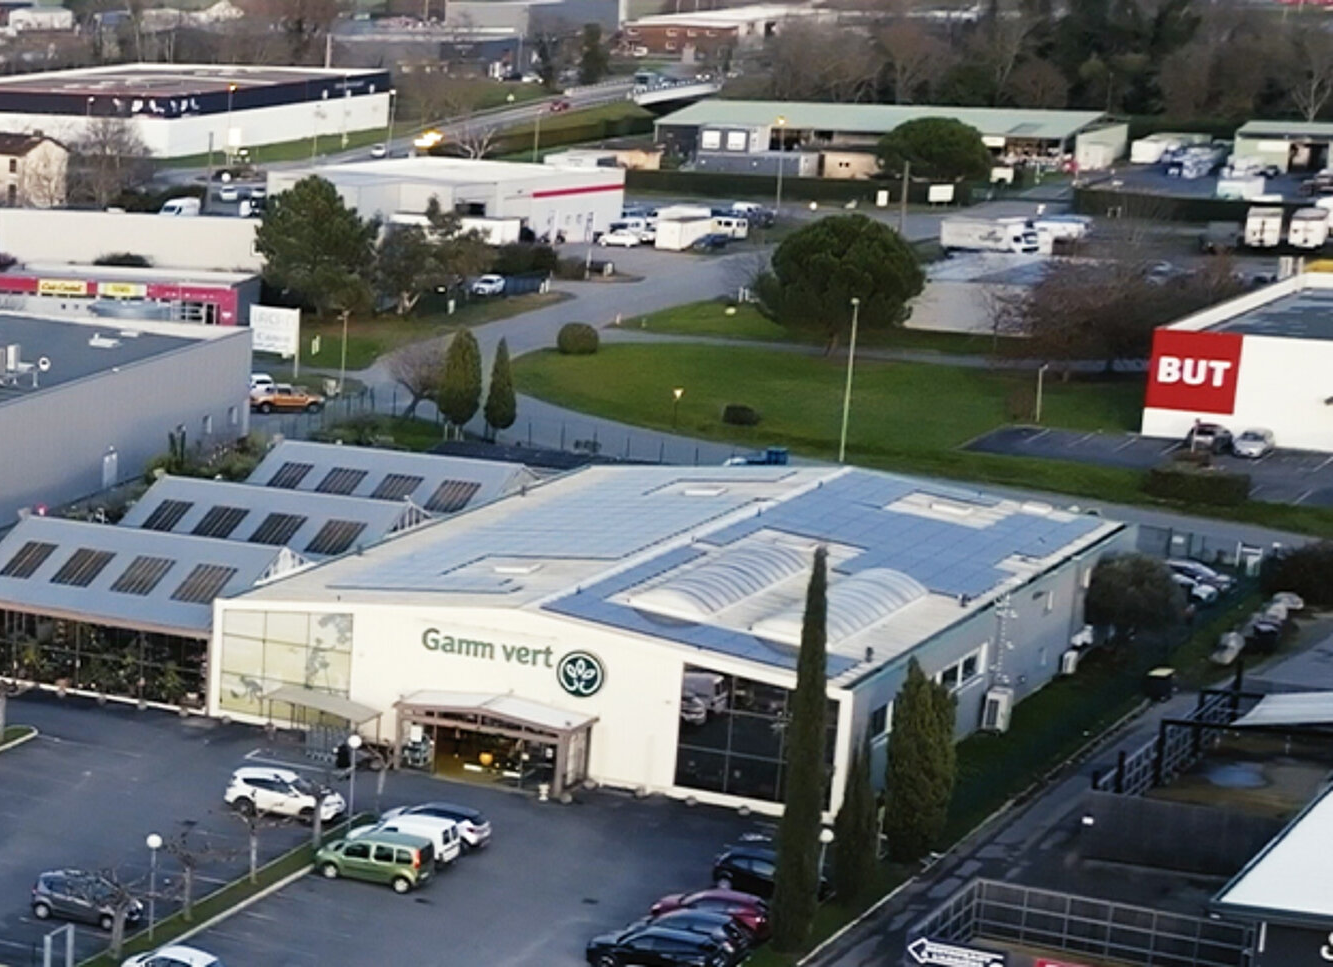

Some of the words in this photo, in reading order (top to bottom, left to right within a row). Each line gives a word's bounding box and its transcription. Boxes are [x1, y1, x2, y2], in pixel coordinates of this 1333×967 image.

[1157, 356, 1231, 387] BUT
[422, 628, 495, 660] Gamm
[502, 644, 554, 668] vert
